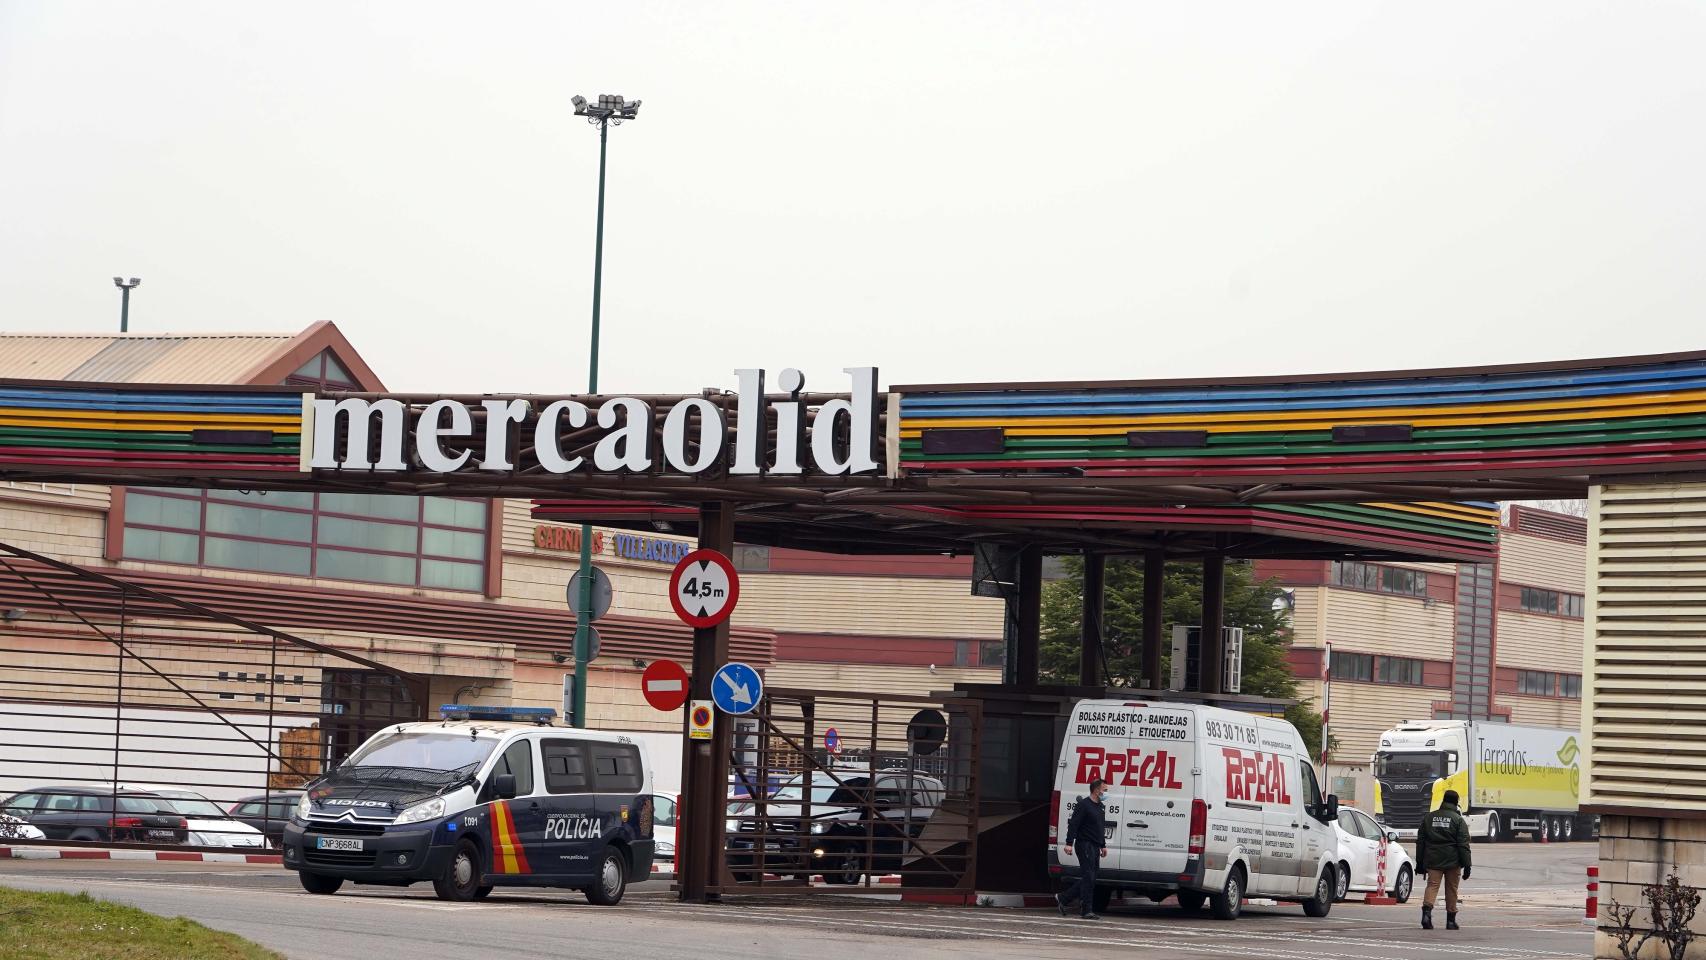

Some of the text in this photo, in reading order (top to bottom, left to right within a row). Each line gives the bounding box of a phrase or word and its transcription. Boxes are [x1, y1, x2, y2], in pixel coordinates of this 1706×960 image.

[311, 365, 879, 475] mercaolid
[534, 525, 604, 554] CARNIAS
[1078, 711, 1106, 722] BOLSAS
[1148, 714, 1188, 727] BANDEJAS
[1077, 724, 1186, 740] ENVOLTORIOS ETIQUETADO
[1205, 720, 1257, 745] 983 30 71 85
[1074, 746, 1183, 790] PAPECAL
[1478, 737, 1527, 776] Terrados
[1221, 747, 1291, 805] PAPECAL
[1109, 805, 1120, 814] 85
[1128, 808, 1186, 819] www.papecal.com
[468, 816, 478, 827] 091
[544, 817, 602, 840] POLICIA
[321, 839, 362, 850] CNP3668AL
